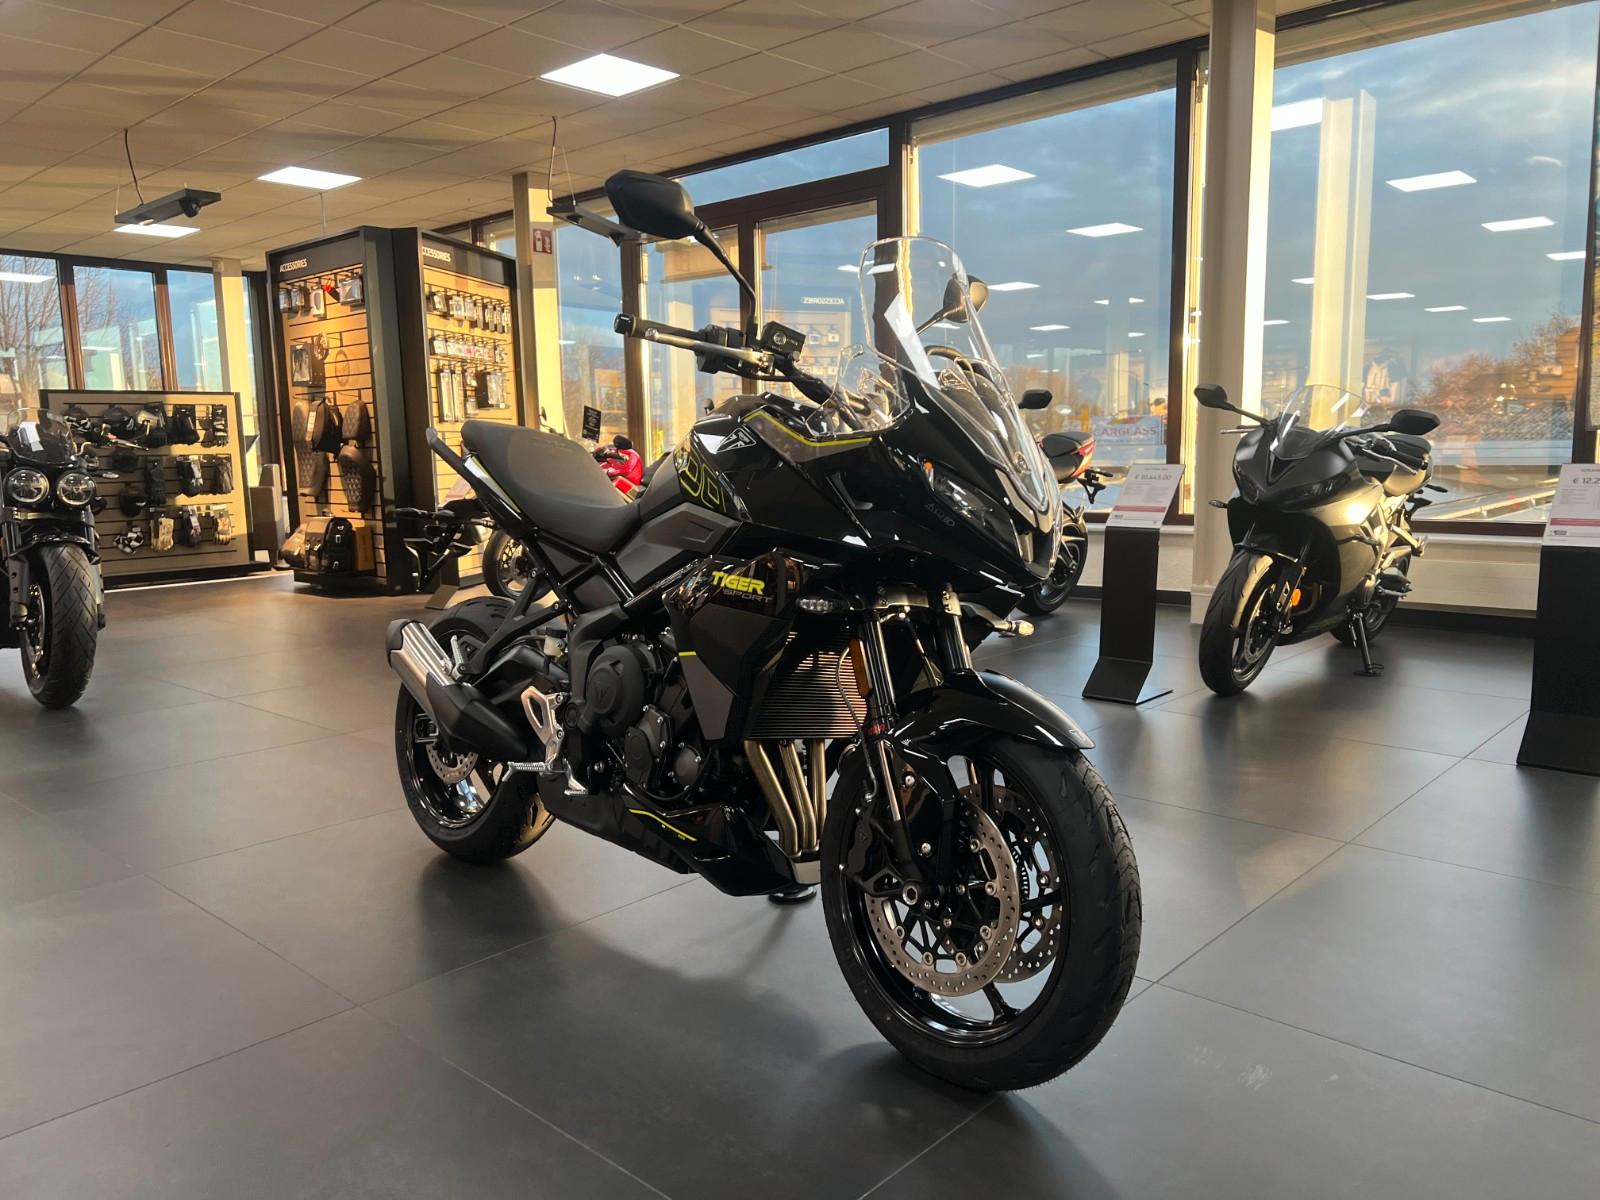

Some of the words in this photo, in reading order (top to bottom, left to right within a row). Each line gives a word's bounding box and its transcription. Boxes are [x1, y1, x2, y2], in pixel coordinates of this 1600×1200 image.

[422, 246, 451, 262] CCESSORIES
[279, 258, 307, 272] ACCESSORIES
[711, 570, 765, 596] TIGER
[722, 587, 773, 603] SPORT
